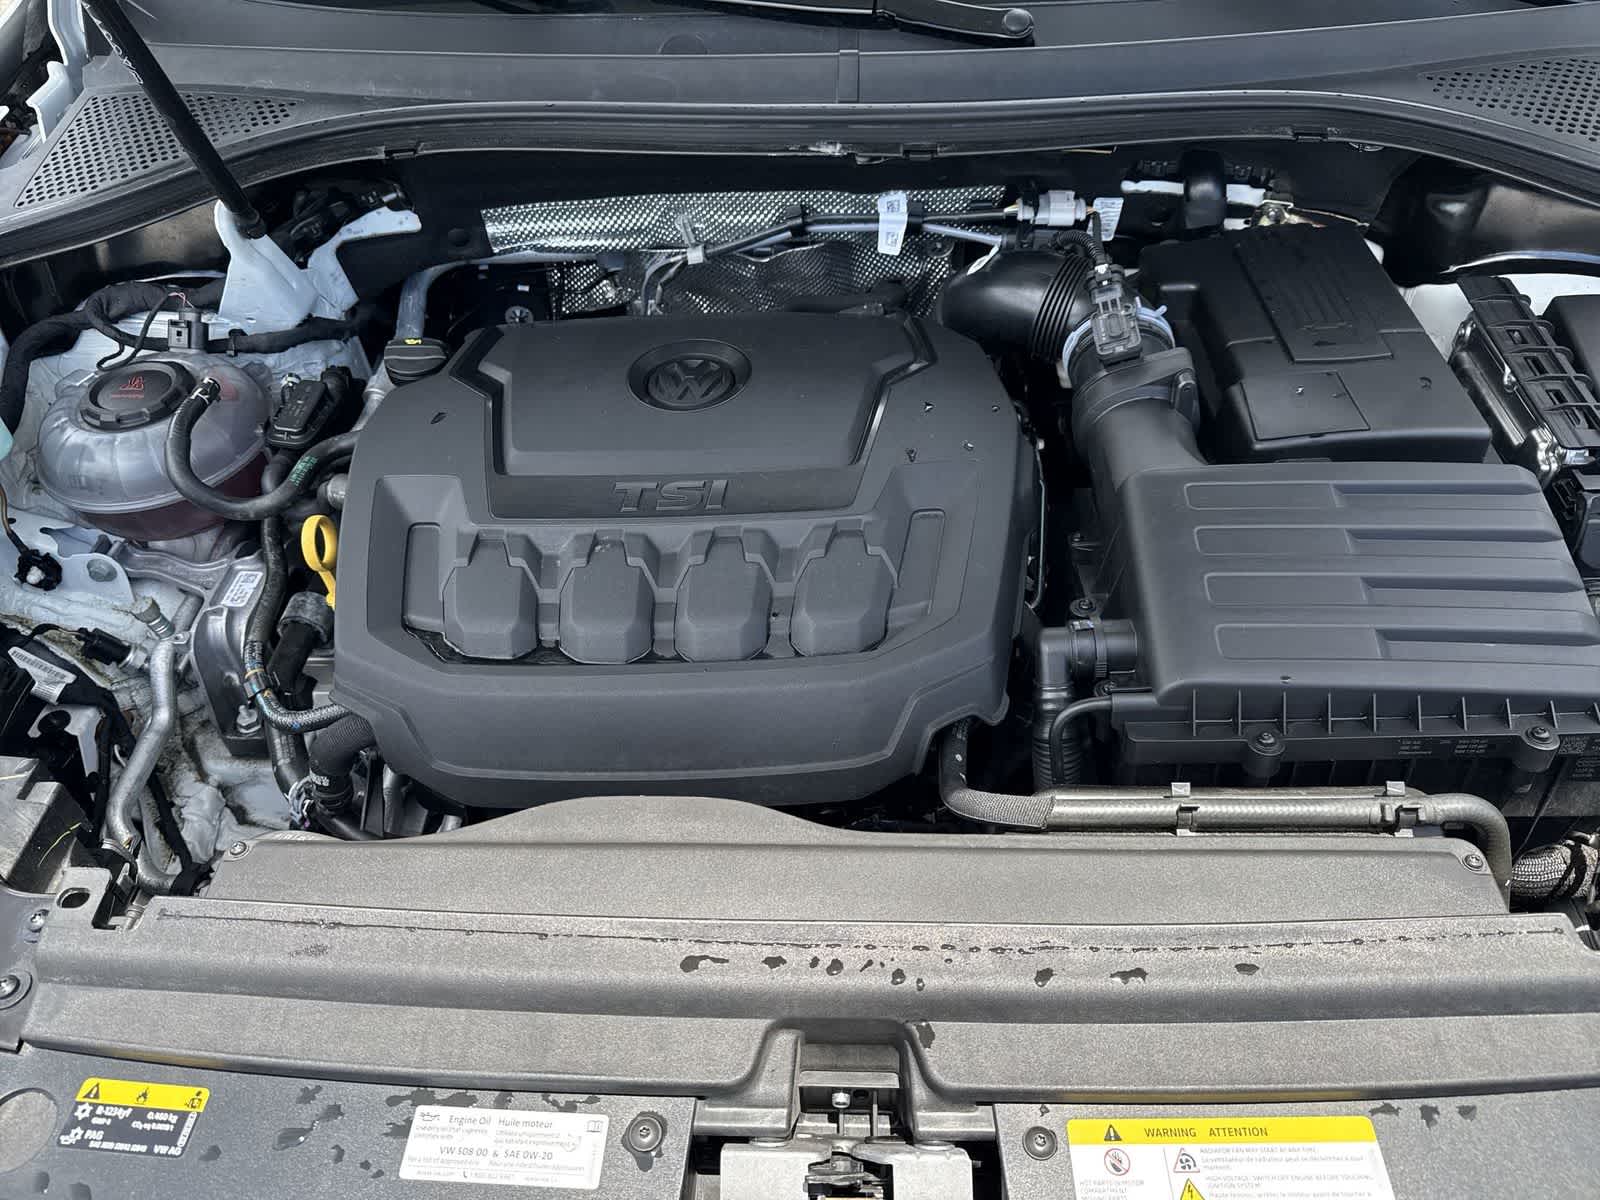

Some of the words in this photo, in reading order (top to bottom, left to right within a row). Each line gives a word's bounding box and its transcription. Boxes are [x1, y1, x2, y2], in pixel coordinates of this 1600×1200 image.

[613, 478, 729, 513] TSI
[448, 1115, 477, 1126] Engine
[479, 1116, 491, 1125] Oil
[498, 1119, 520, 1127] Huile
[522, 1120, 553, 1129] moteur
[84, 1129, 104, 1140] PAG
[1144, 1127, 1197, 1138] WARNING
[1209, 1127, 1269, 1137] ATTENTION
[153, 1144, 169, 1154] VW
[168, 1146, 182, 1155] AG
[440, 1146, 455, 1155] VW
[457, 1147, 474, 1156] 508
[476, 1148, 488, 1156] 00
[504, 1150, 520, 1159] SAE
[522, 1151, 553, 1160] 0W-20
